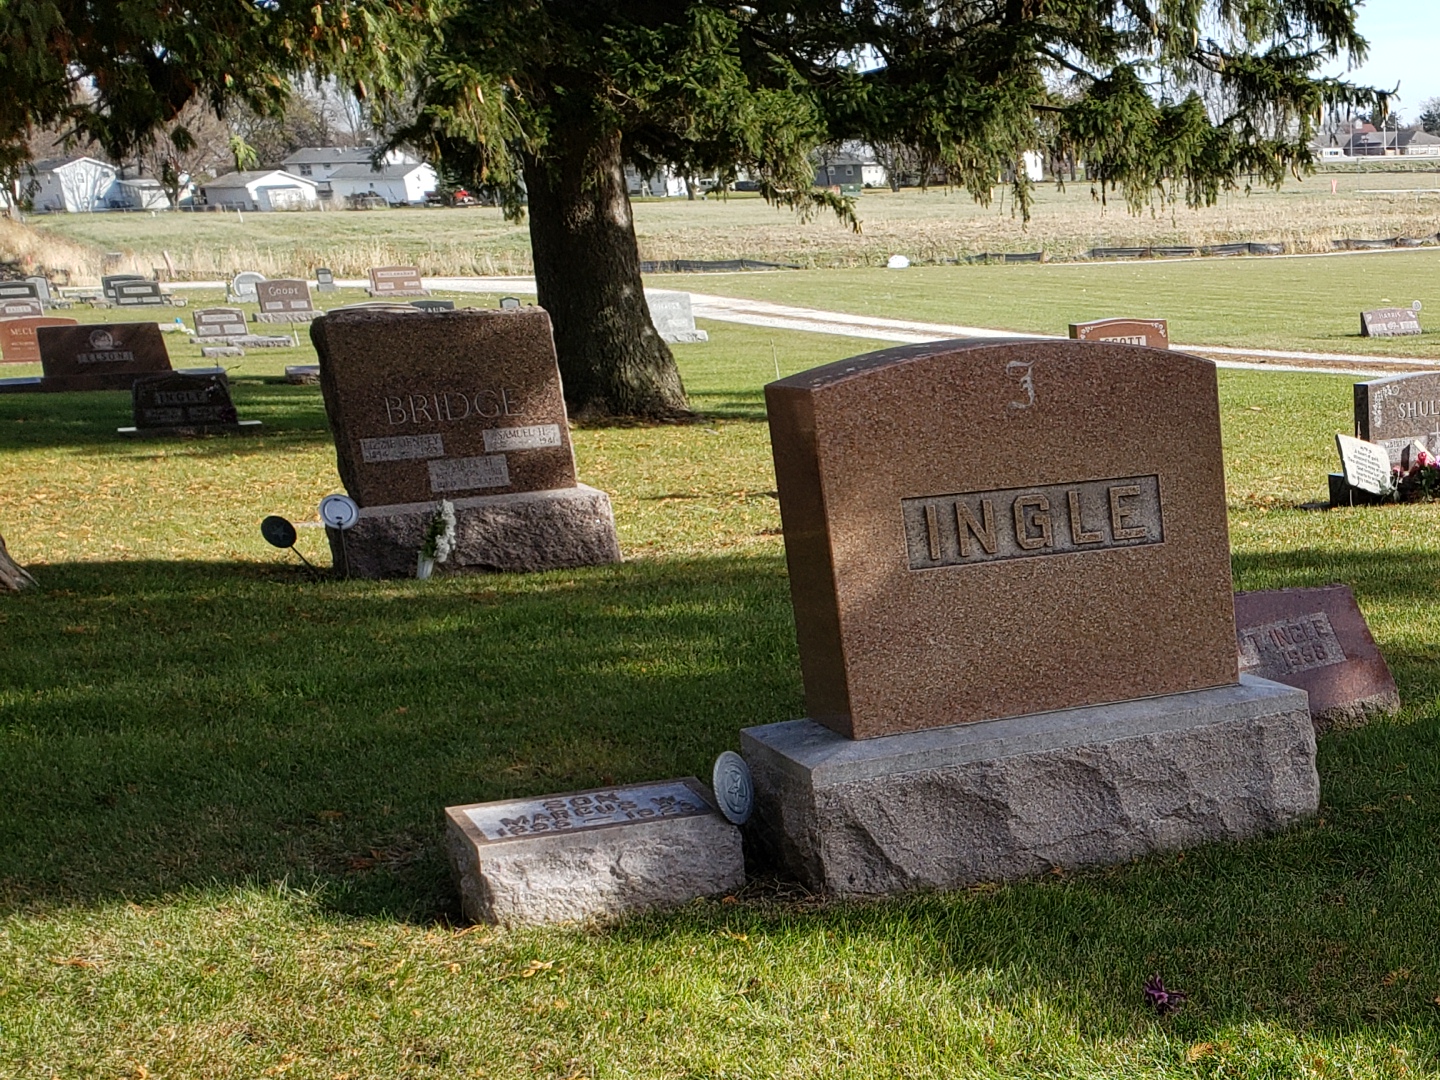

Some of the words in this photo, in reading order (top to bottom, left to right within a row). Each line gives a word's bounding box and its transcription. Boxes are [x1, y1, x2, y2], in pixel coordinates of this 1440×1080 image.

[384, 386, 523, 426] BRIDGE
[925, 484, 1147, 561] INGLE
[499, 801, 638, 829] MARCUS
[543, 792, 620, 812] SON
